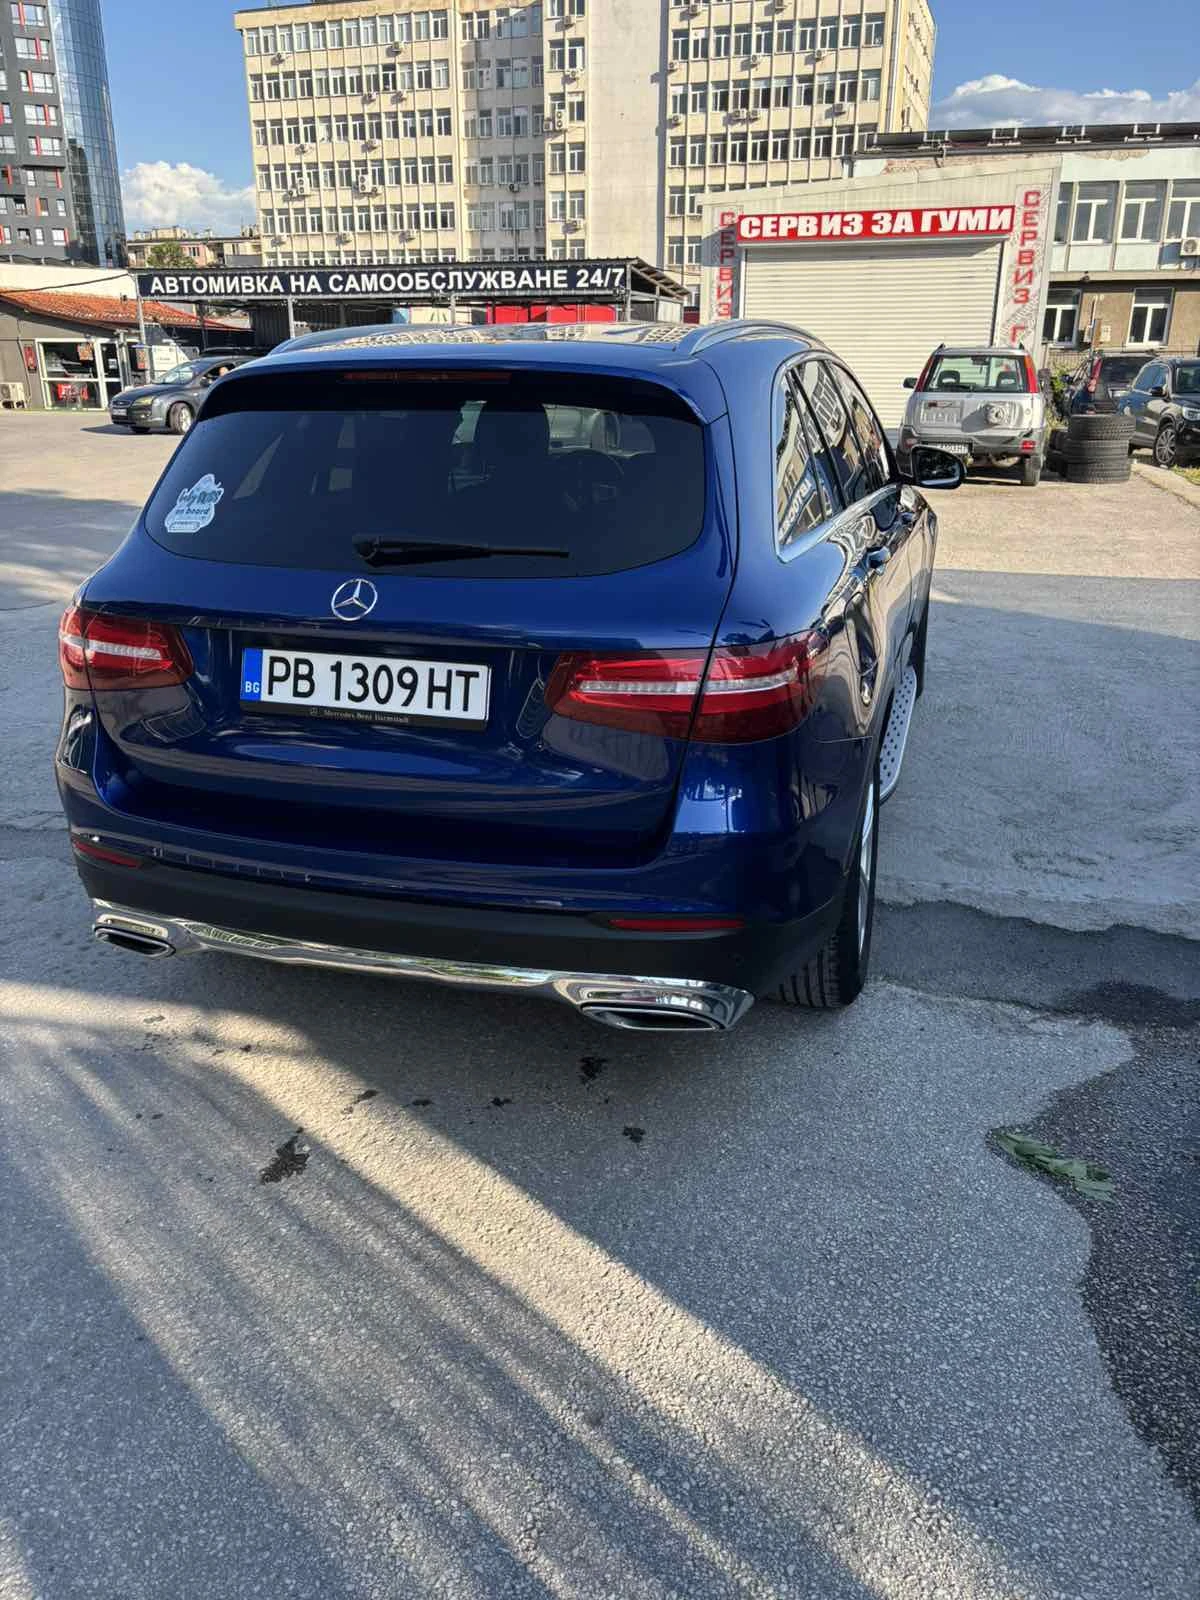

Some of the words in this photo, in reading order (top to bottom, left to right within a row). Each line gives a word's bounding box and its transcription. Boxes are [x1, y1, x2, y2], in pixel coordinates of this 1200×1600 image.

[740, 213, 863, 238] СЕРВИЗ
[872, 211, 914, 234] ЗА
[921, 207, 1013, 233] ГУМИ
[715, 212, 736, 316] СЕРВИЗ
[1013, 191, 1041, 304] СЕРВИЗ
[150, 275, 284, 294] АВТОМИВКА
[290, 275, 322, 293] НА
[328, 269, 568, 293] САМООБСЛУЖВАНЕ
[576, 268, 625, 288] 24/7
[245, 681, 260, 694] BG
[267, 655, 315, 699] PB
[330, 660, 420, 708] 1309
[426, 667, 480, 713] HT
